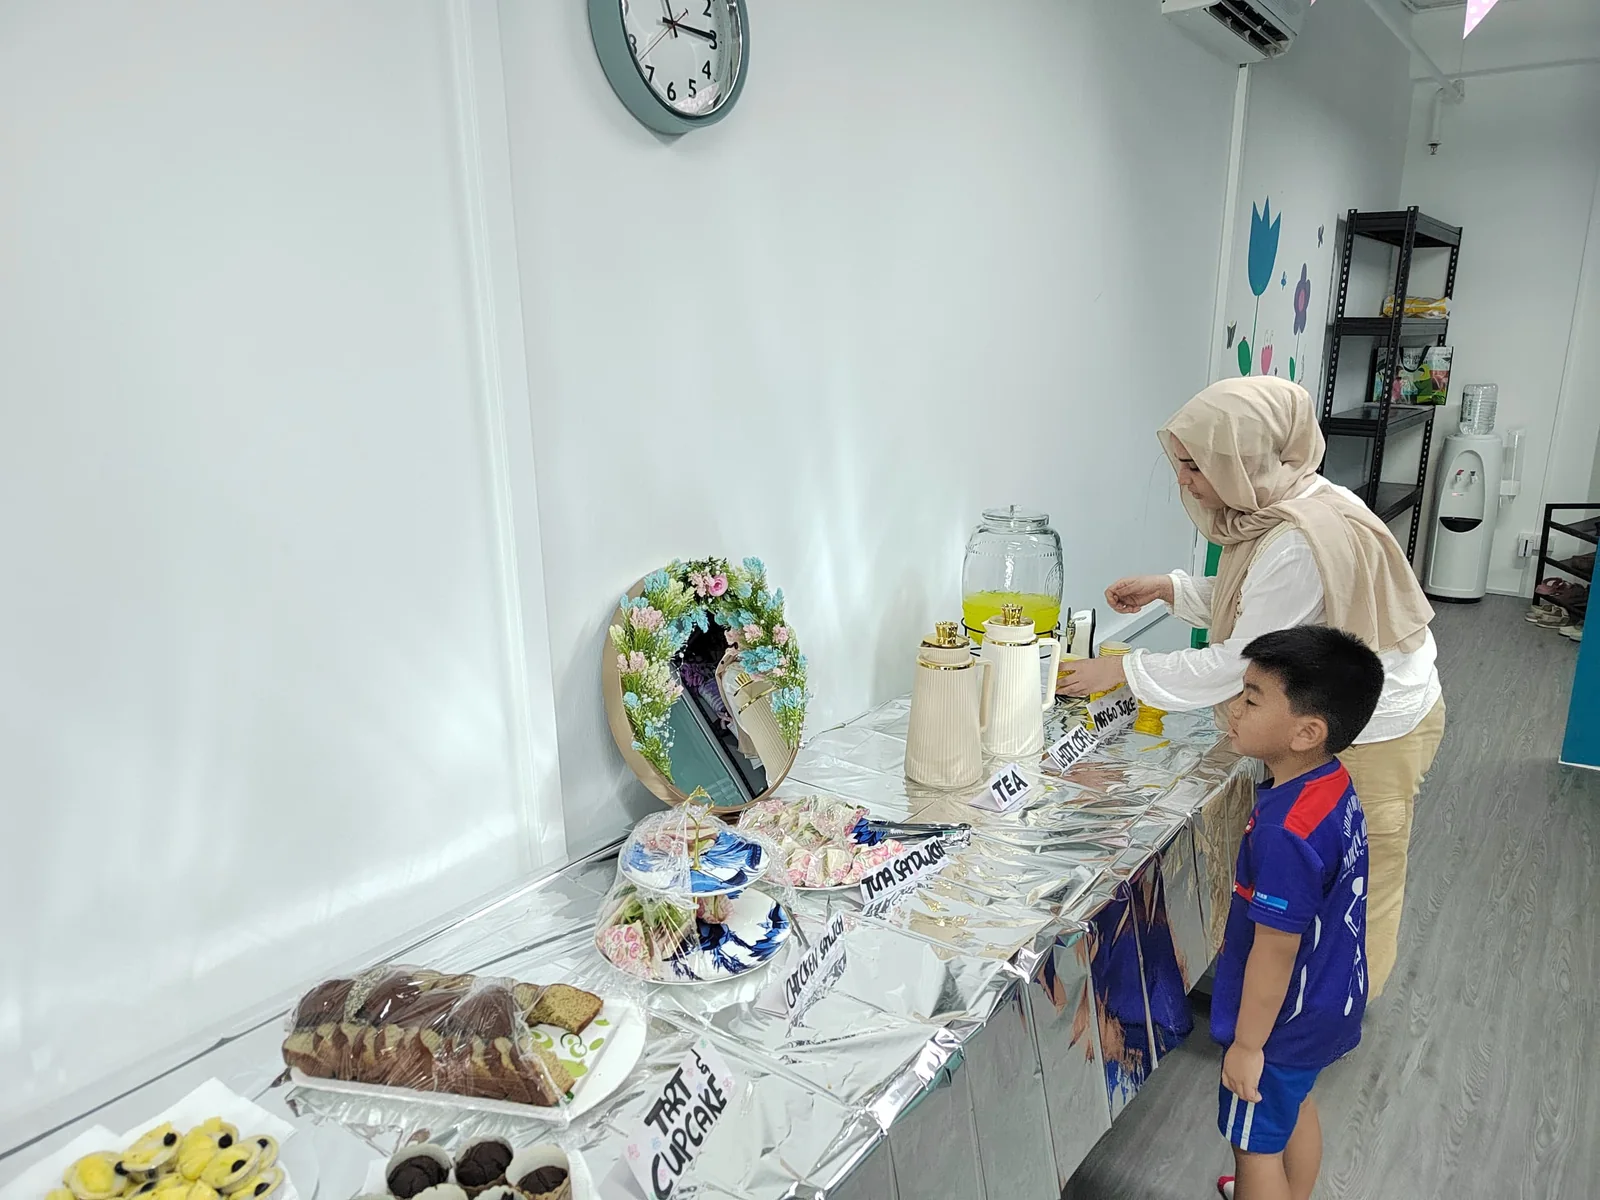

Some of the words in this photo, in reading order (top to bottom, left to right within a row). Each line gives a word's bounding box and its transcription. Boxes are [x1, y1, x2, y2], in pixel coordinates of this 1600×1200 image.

[703, 0, 712, 17] 2
[709, 29, 718, 50] 3
[645, 64, 655, 83] 7
[702, 60, 711, 80] 4
[667, 81, 676, 101] 6
[688, 78, 697, 99] 5
[992, 770, 1029, 802] TEA
[861, 867, 896, 900] TUNA
[893, 839, 947, 882] SANDWICH
[785, 946, 819, 1009] CHICKEN
[643, 1066, 692, 1137] TART
[651, 1073, 727, 1200] CUPCAKE
